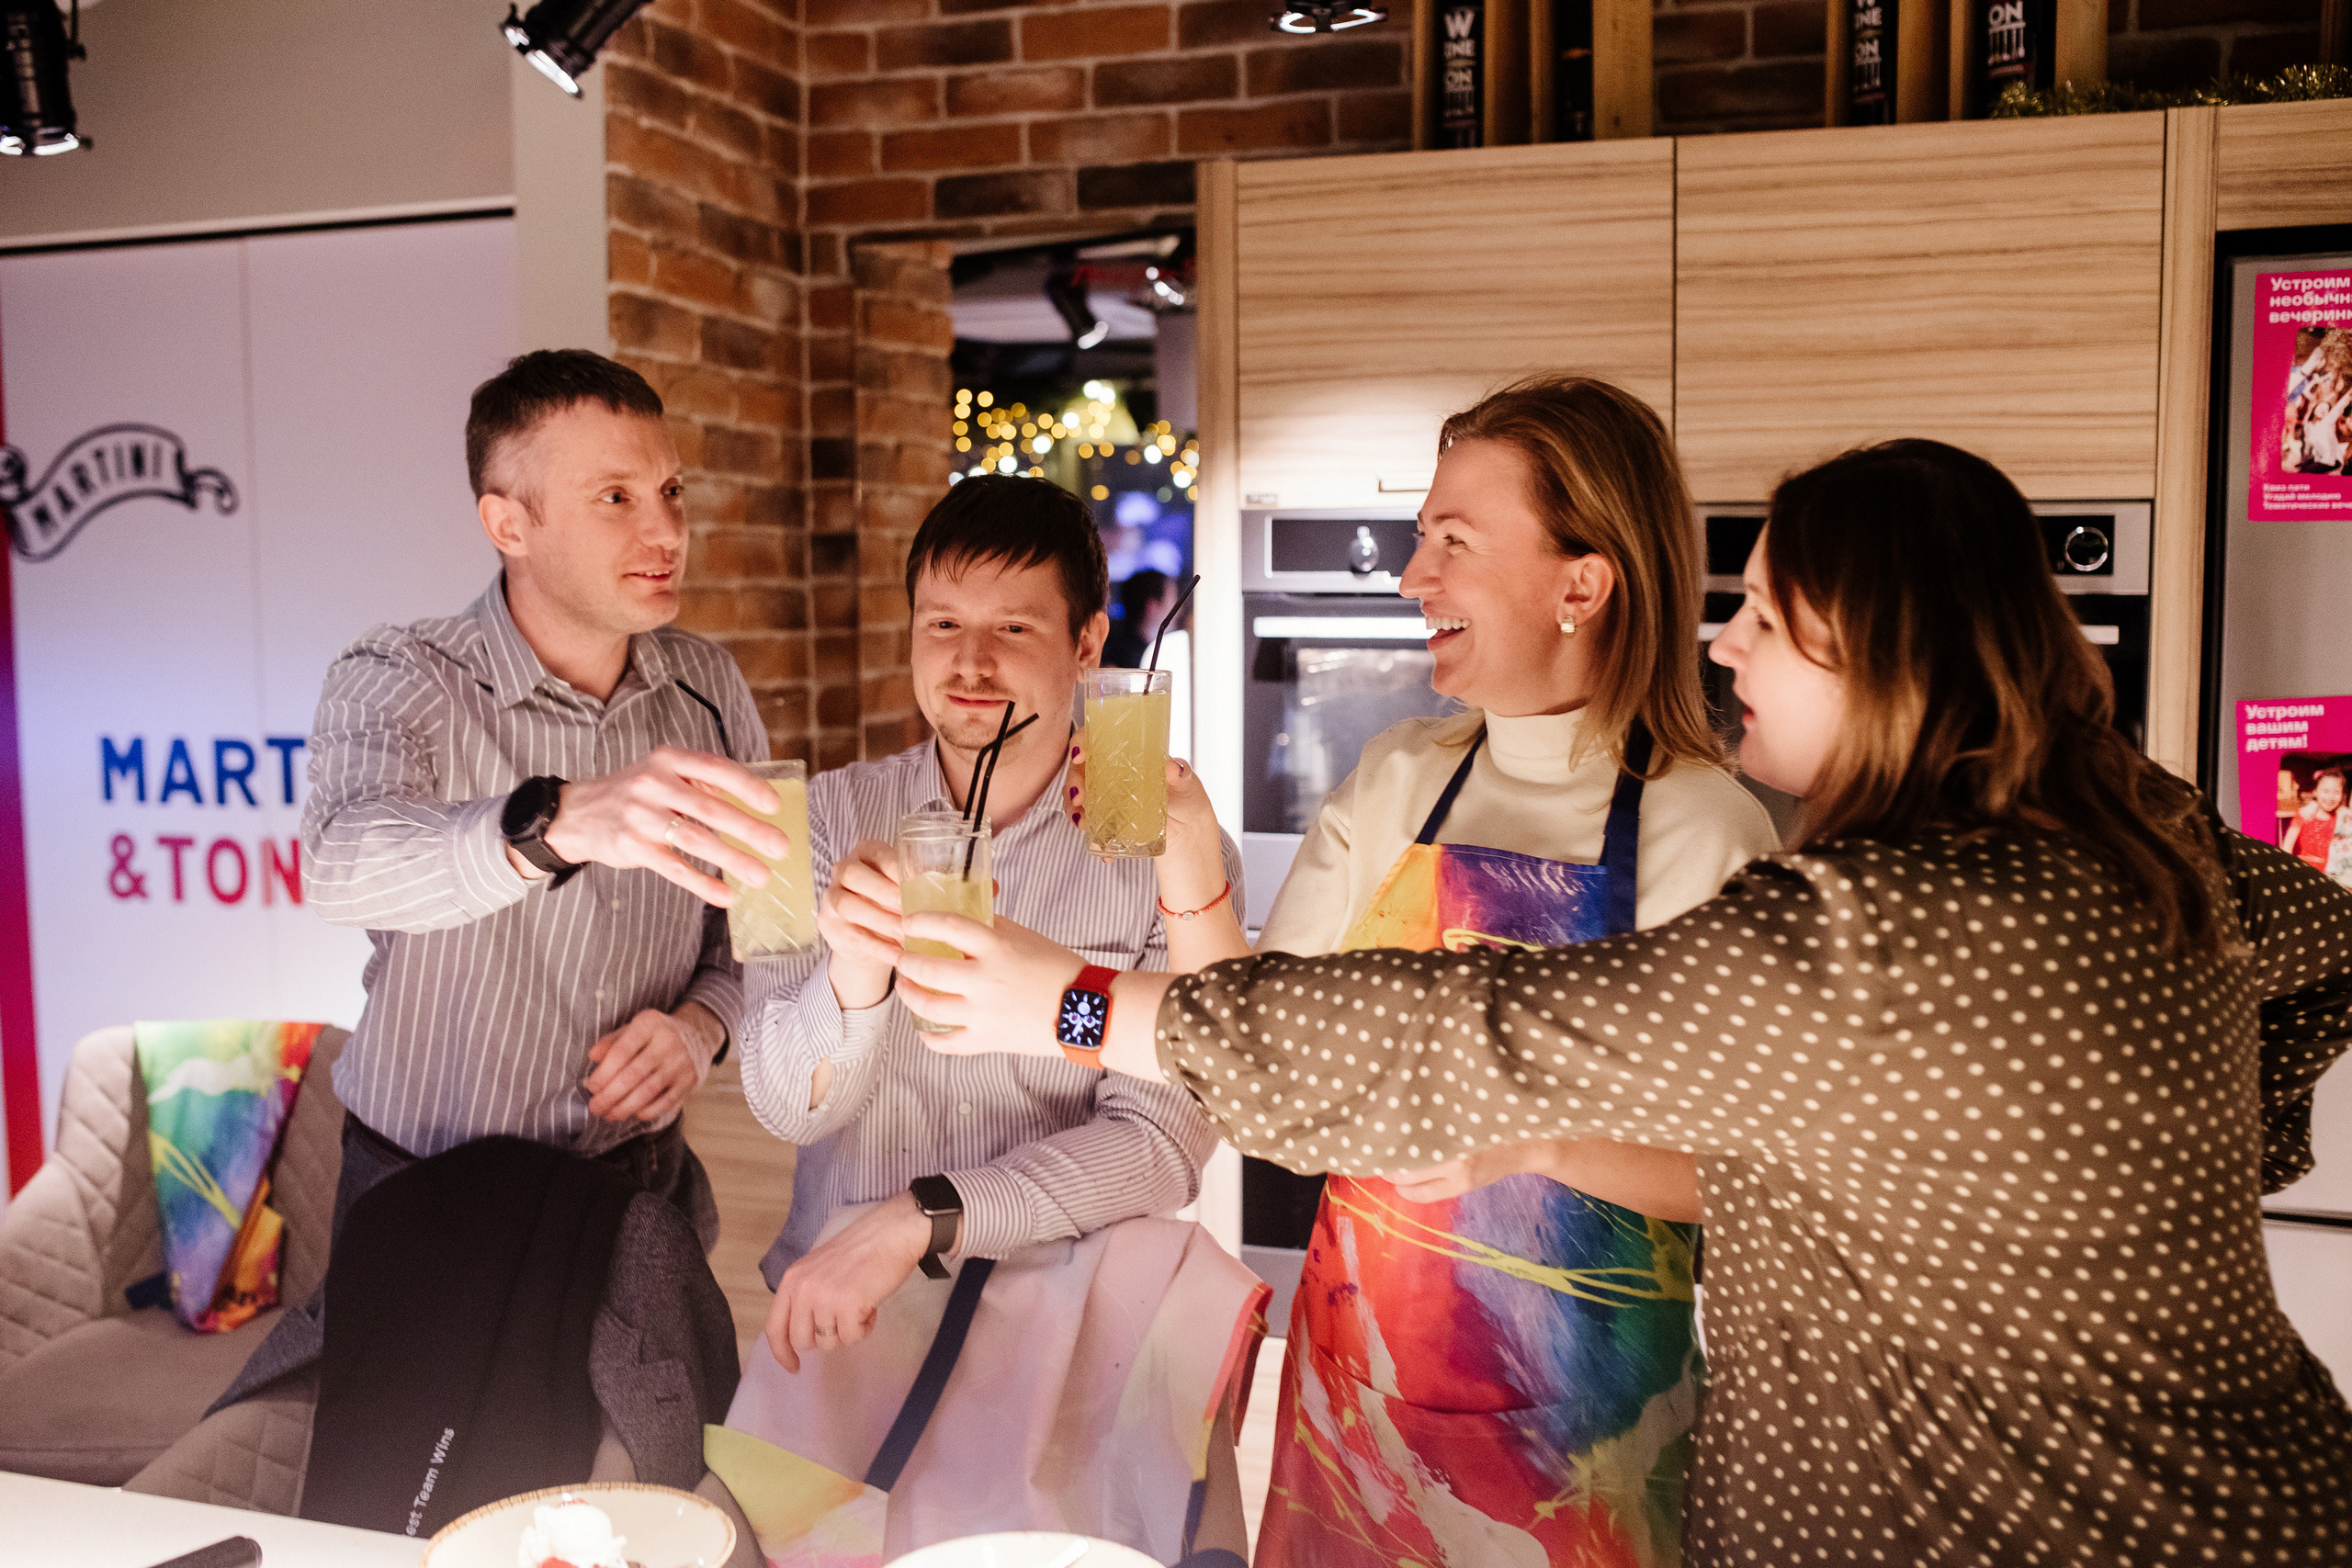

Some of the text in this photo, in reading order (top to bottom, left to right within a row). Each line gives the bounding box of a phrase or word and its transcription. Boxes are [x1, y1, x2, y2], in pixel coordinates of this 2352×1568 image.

[2270, 276, 2351, 293] Устроим
[2269, 290, 2352, 308] необычн
[2245, 705, 2325, 721] Устроим
[2245, 721, 2309, 736] вашим
[2245, 734, 2309, 752] детям!
[99, 737, 306, 807] MART
[107, 833, 303, 906] &TON
[405, 1427, 455, 1537] est Team Wins
